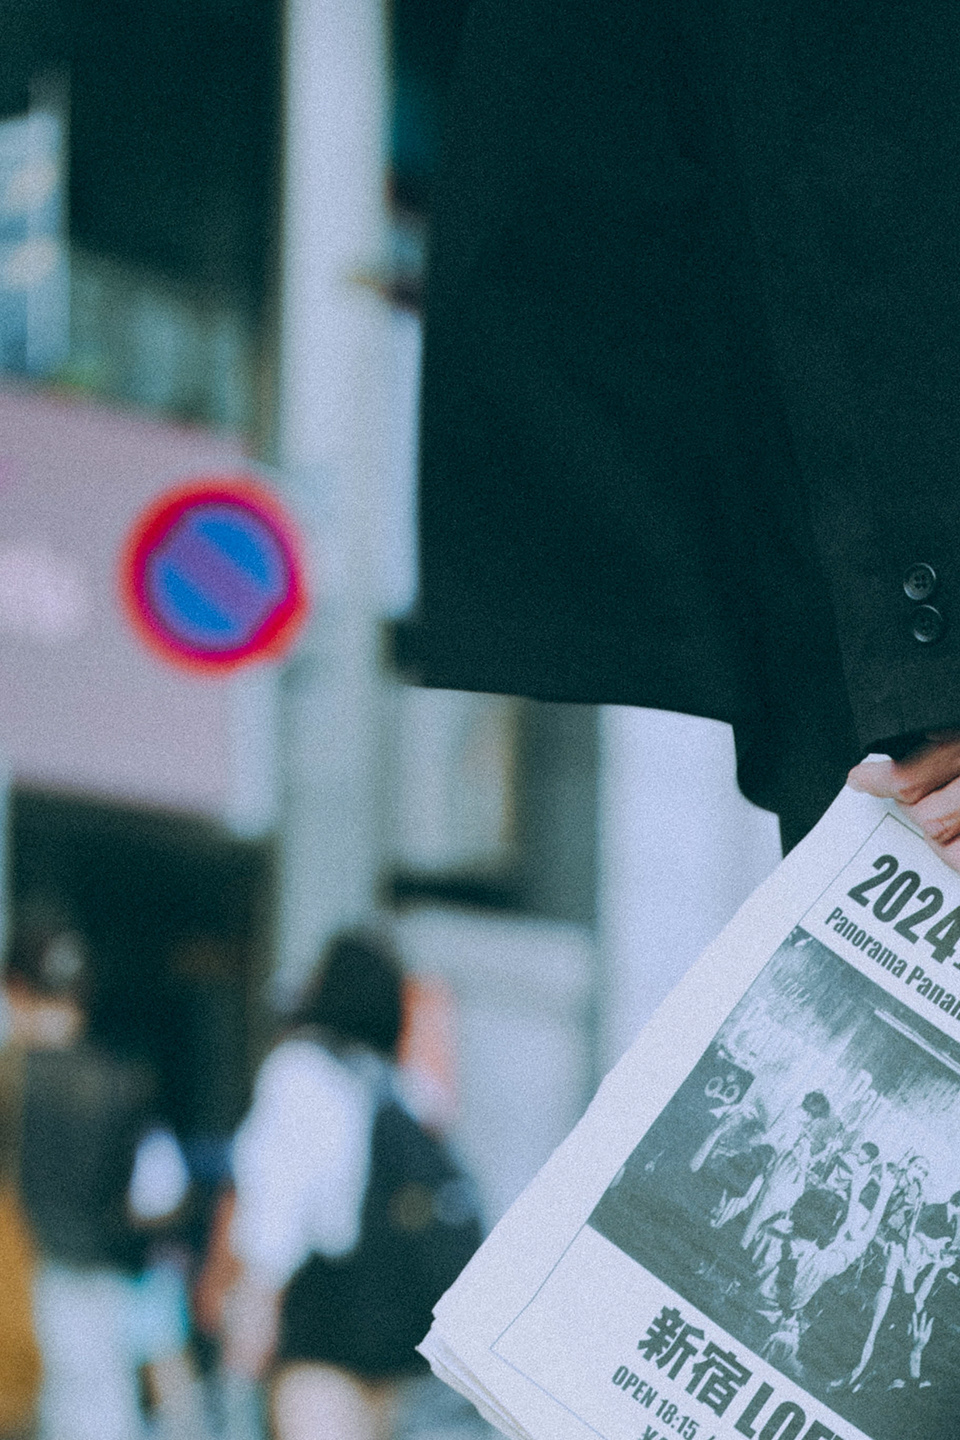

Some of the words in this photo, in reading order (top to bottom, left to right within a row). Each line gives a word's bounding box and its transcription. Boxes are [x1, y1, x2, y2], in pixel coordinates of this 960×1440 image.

[824, 906, 908, 979] Panorama
[611, 1365, 659, 1409] OPEN
[637, 1306, 754, 1418] 新宿
